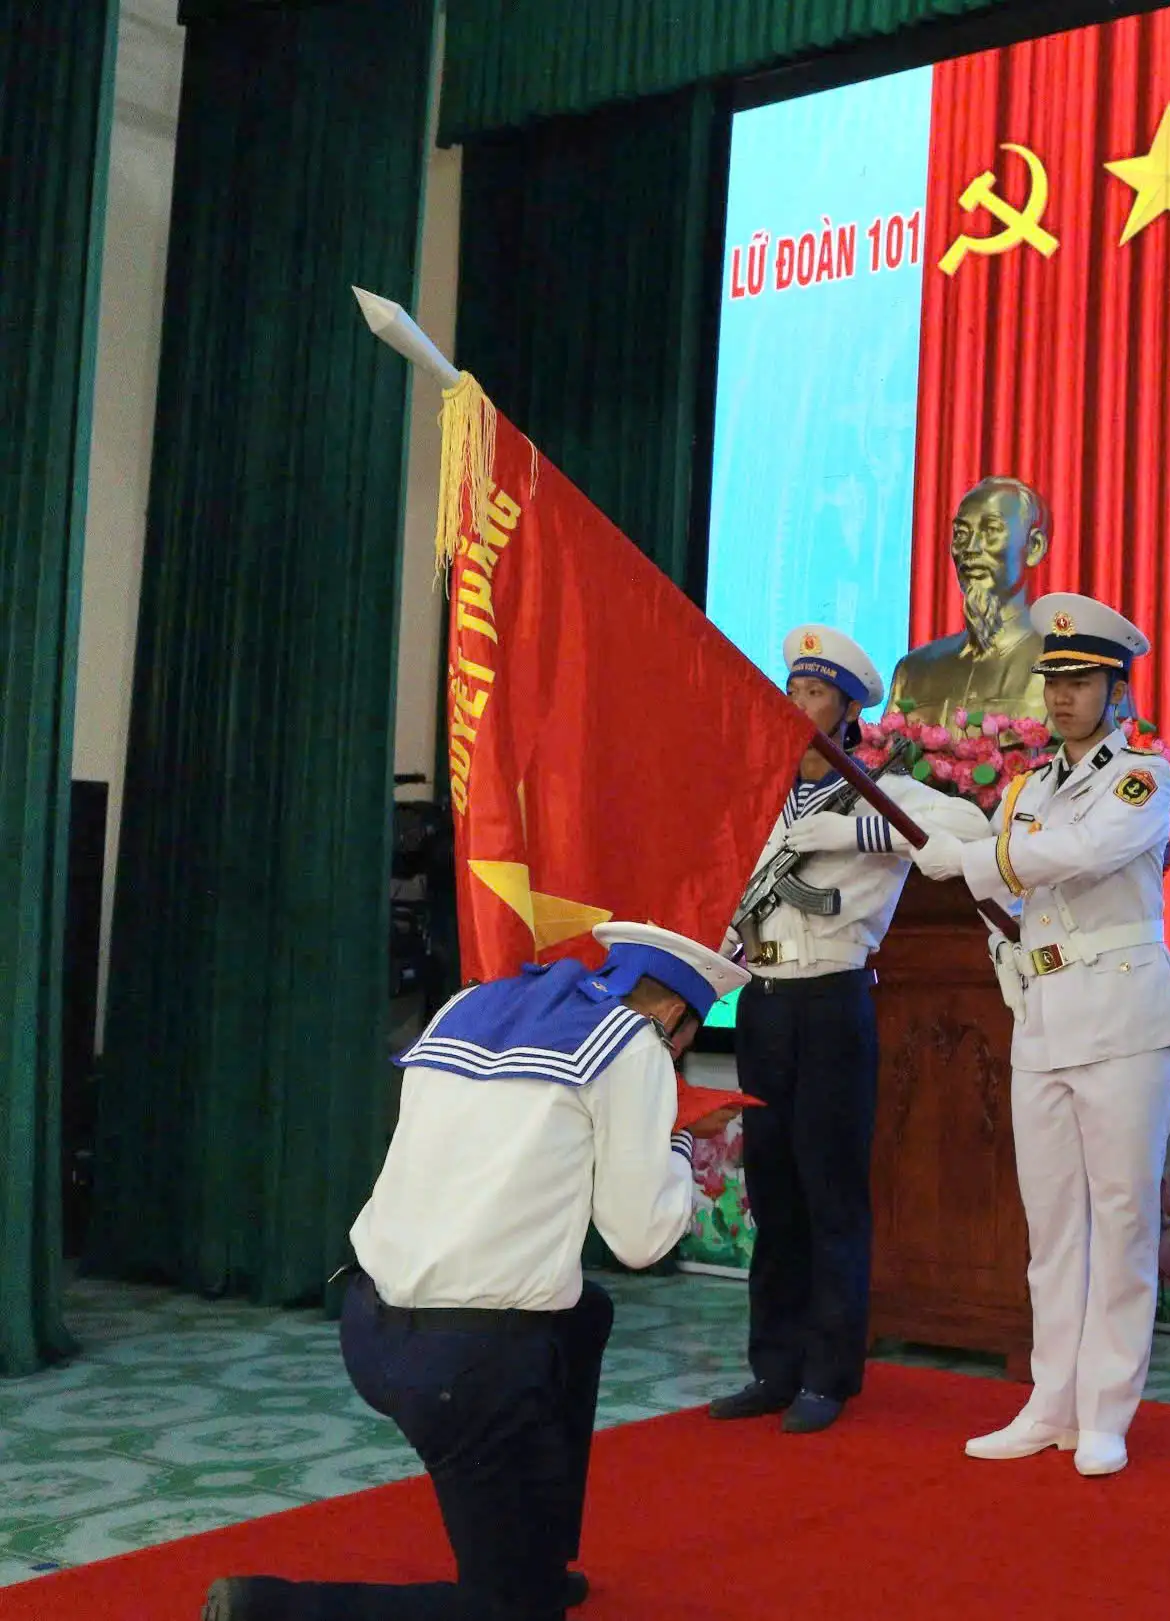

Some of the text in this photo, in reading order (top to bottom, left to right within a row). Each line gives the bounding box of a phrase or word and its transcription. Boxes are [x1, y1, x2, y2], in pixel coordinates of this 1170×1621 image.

[731, 211, 920, 298] LỮ ĐOÀN 101
